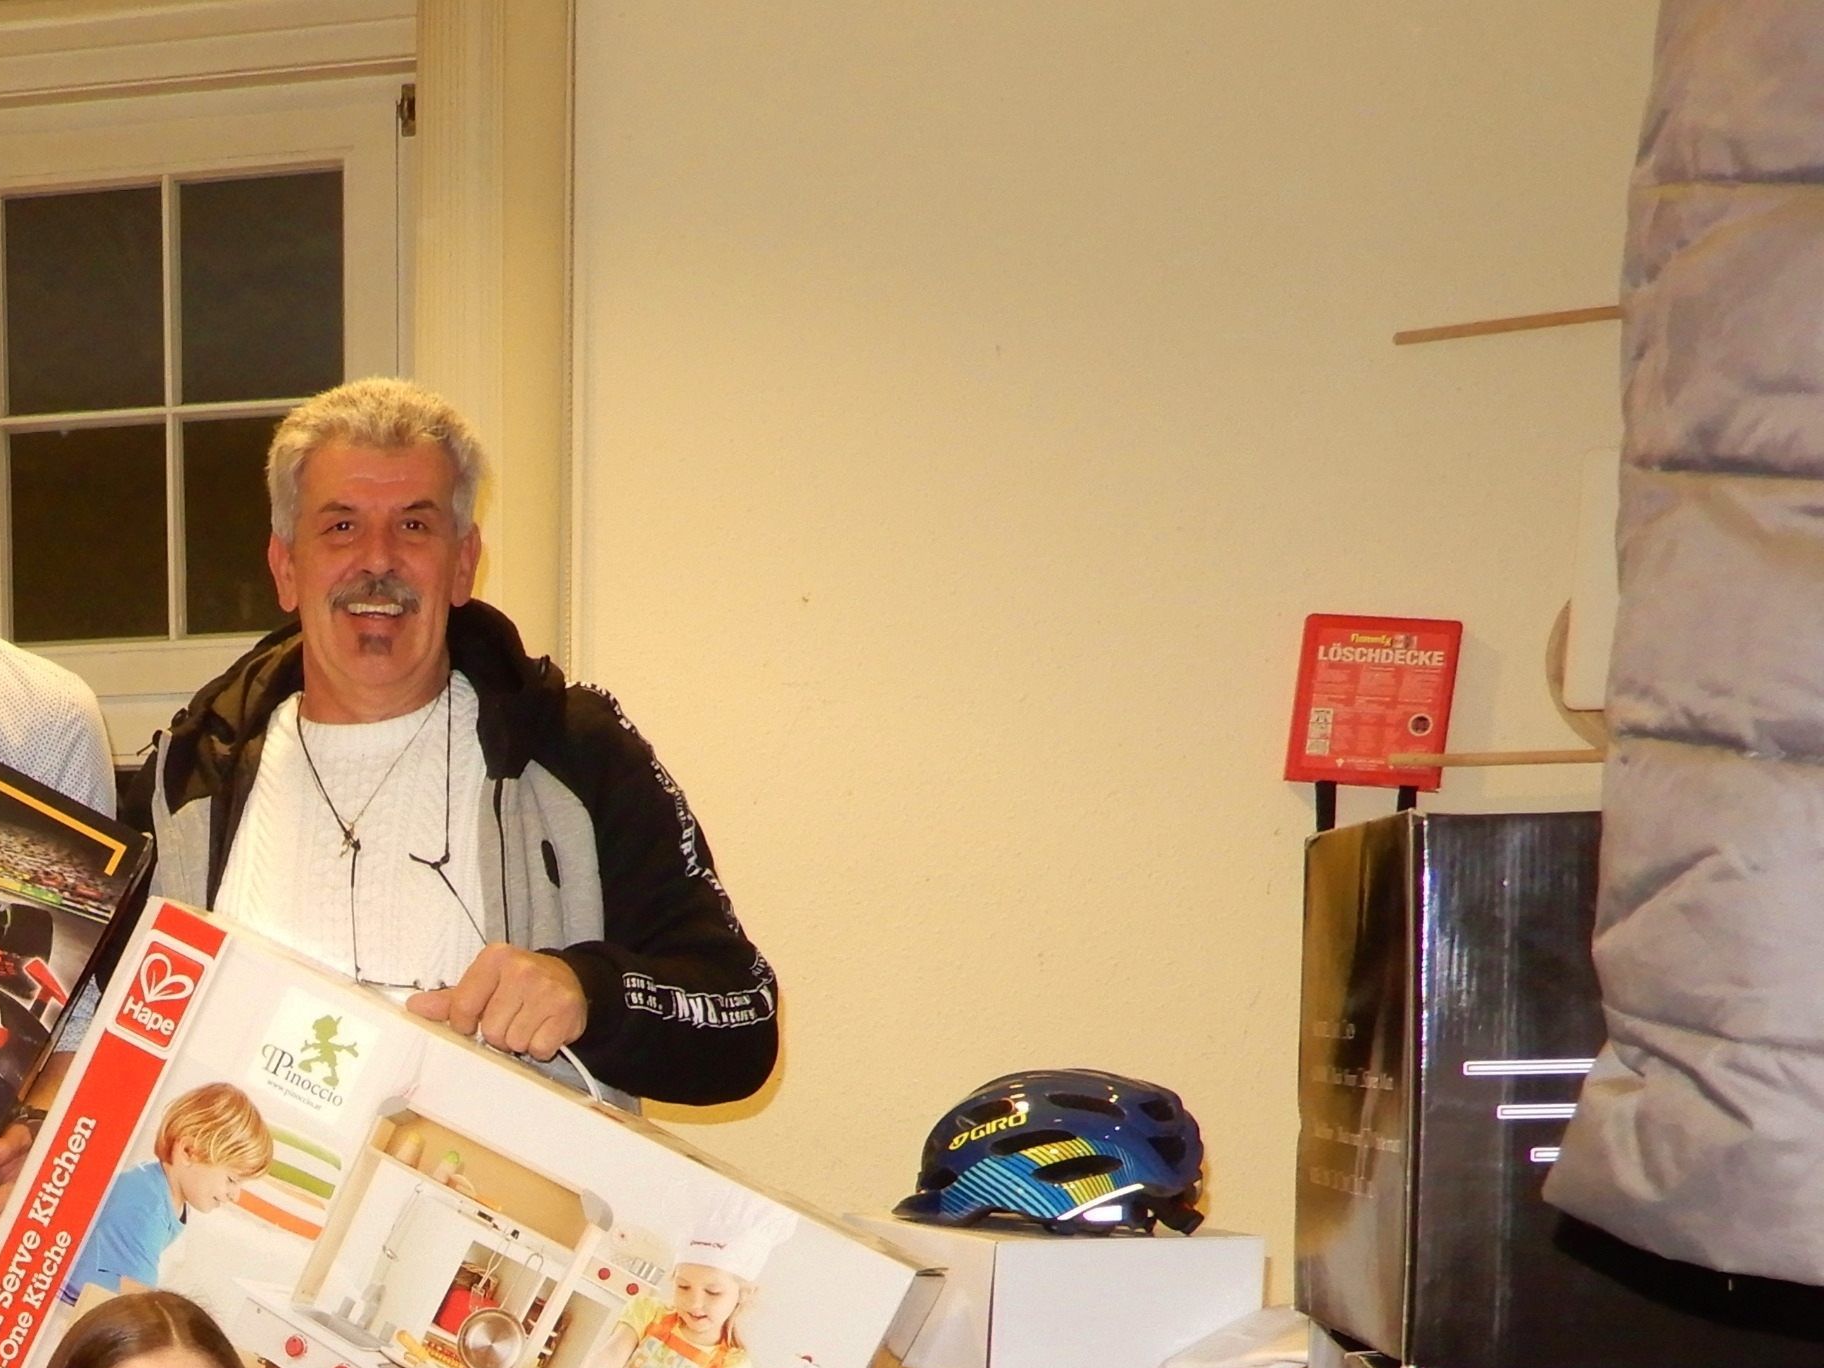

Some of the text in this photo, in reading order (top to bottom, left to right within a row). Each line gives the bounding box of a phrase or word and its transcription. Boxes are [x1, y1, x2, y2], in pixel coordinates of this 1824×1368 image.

[1318, 644, 1444, 667] LÖSCHDECKE
[122, 995, 175, 1036] Hape
[970, 1112, 1027, 1141] GIRO
[27, 1115, 97, 1228] Kitchen
[22, 1230, 73, 1311] Küche
